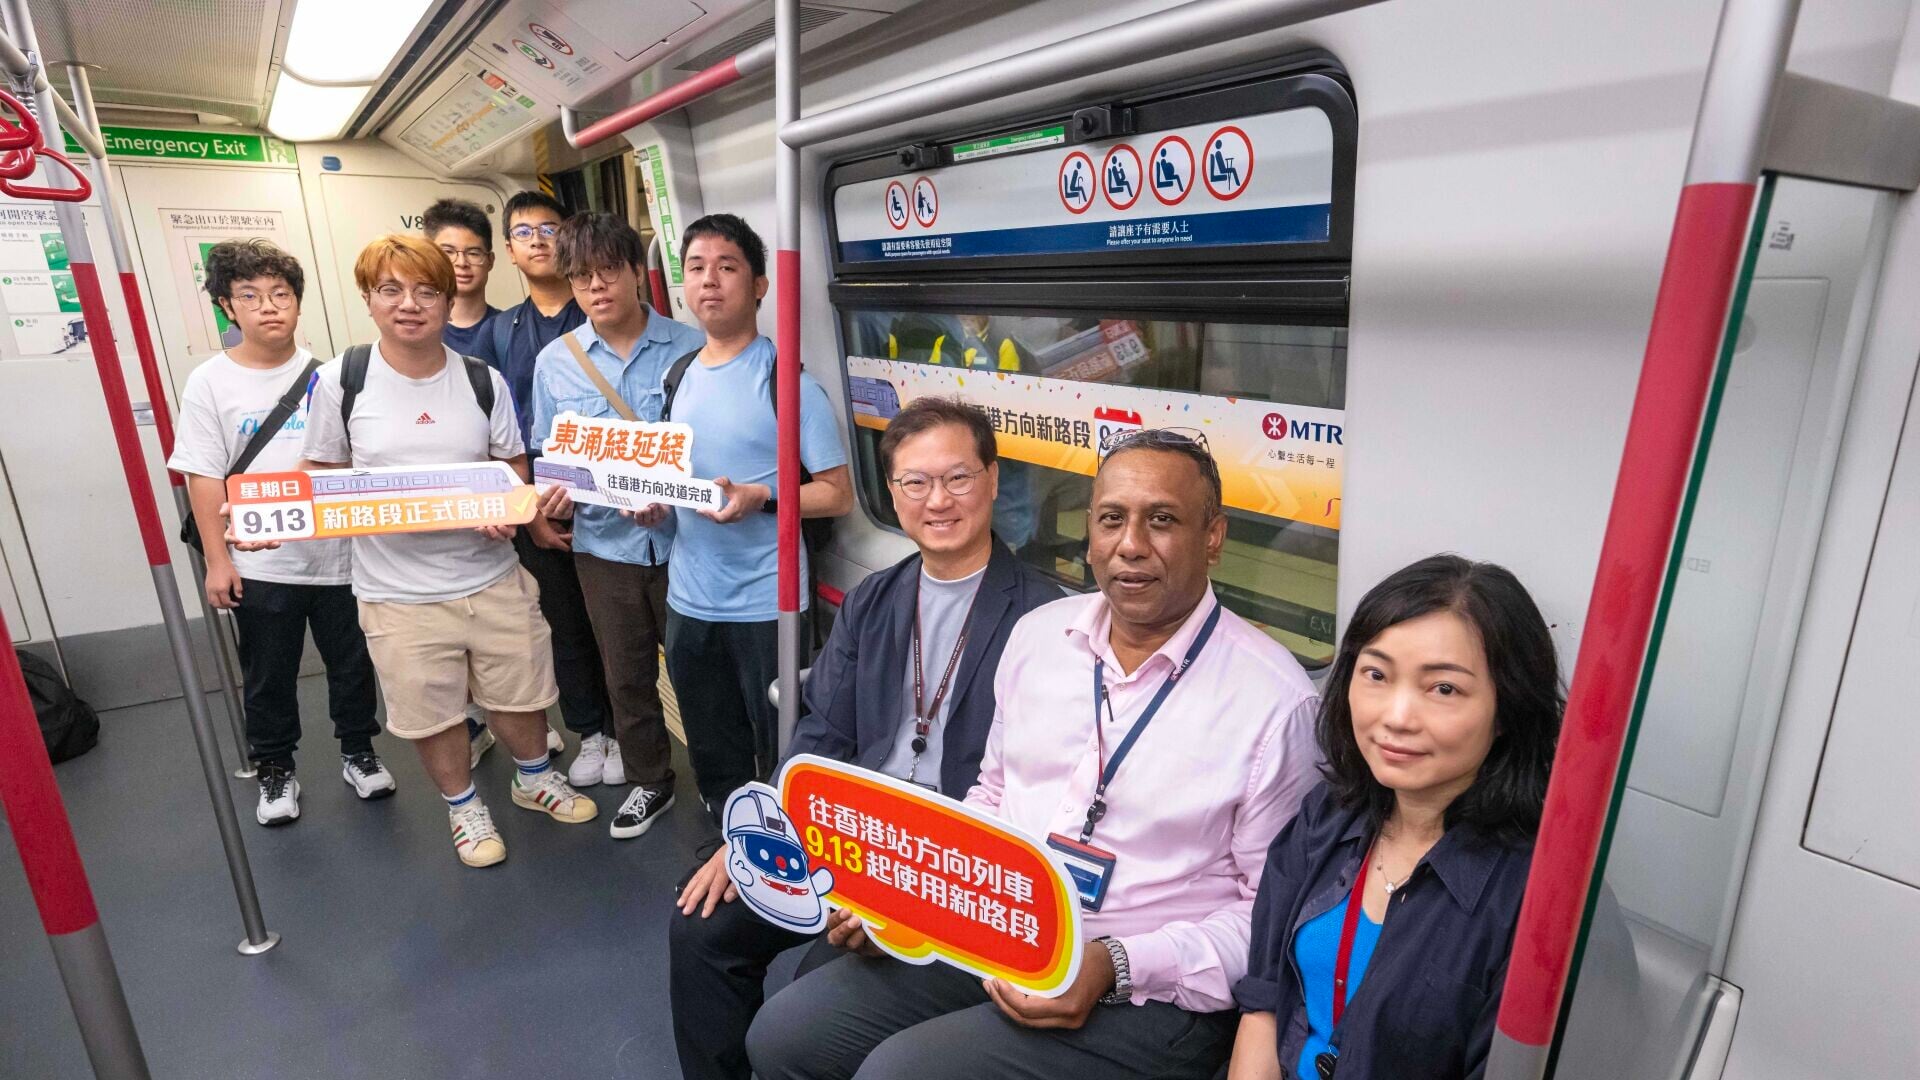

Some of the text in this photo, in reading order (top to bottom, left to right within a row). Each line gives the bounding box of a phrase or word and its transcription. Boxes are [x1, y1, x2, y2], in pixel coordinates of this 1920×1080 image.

[103, 133, 247, 157] Emergency Exit
[1109, 220, 1189, 238] 請讓座予有需要人士
[1290, 419, 1344, 446] MTR
[1267, 449, 1336, 469] 心繫生活每一程
[240, 480, 300, 499] 星期日
[607, 473, 713, 505] 往香港方向改道完成
[242, 508, 306, 534] 9.13
[808, 793, 1034, 904] 往香港站方向列車
